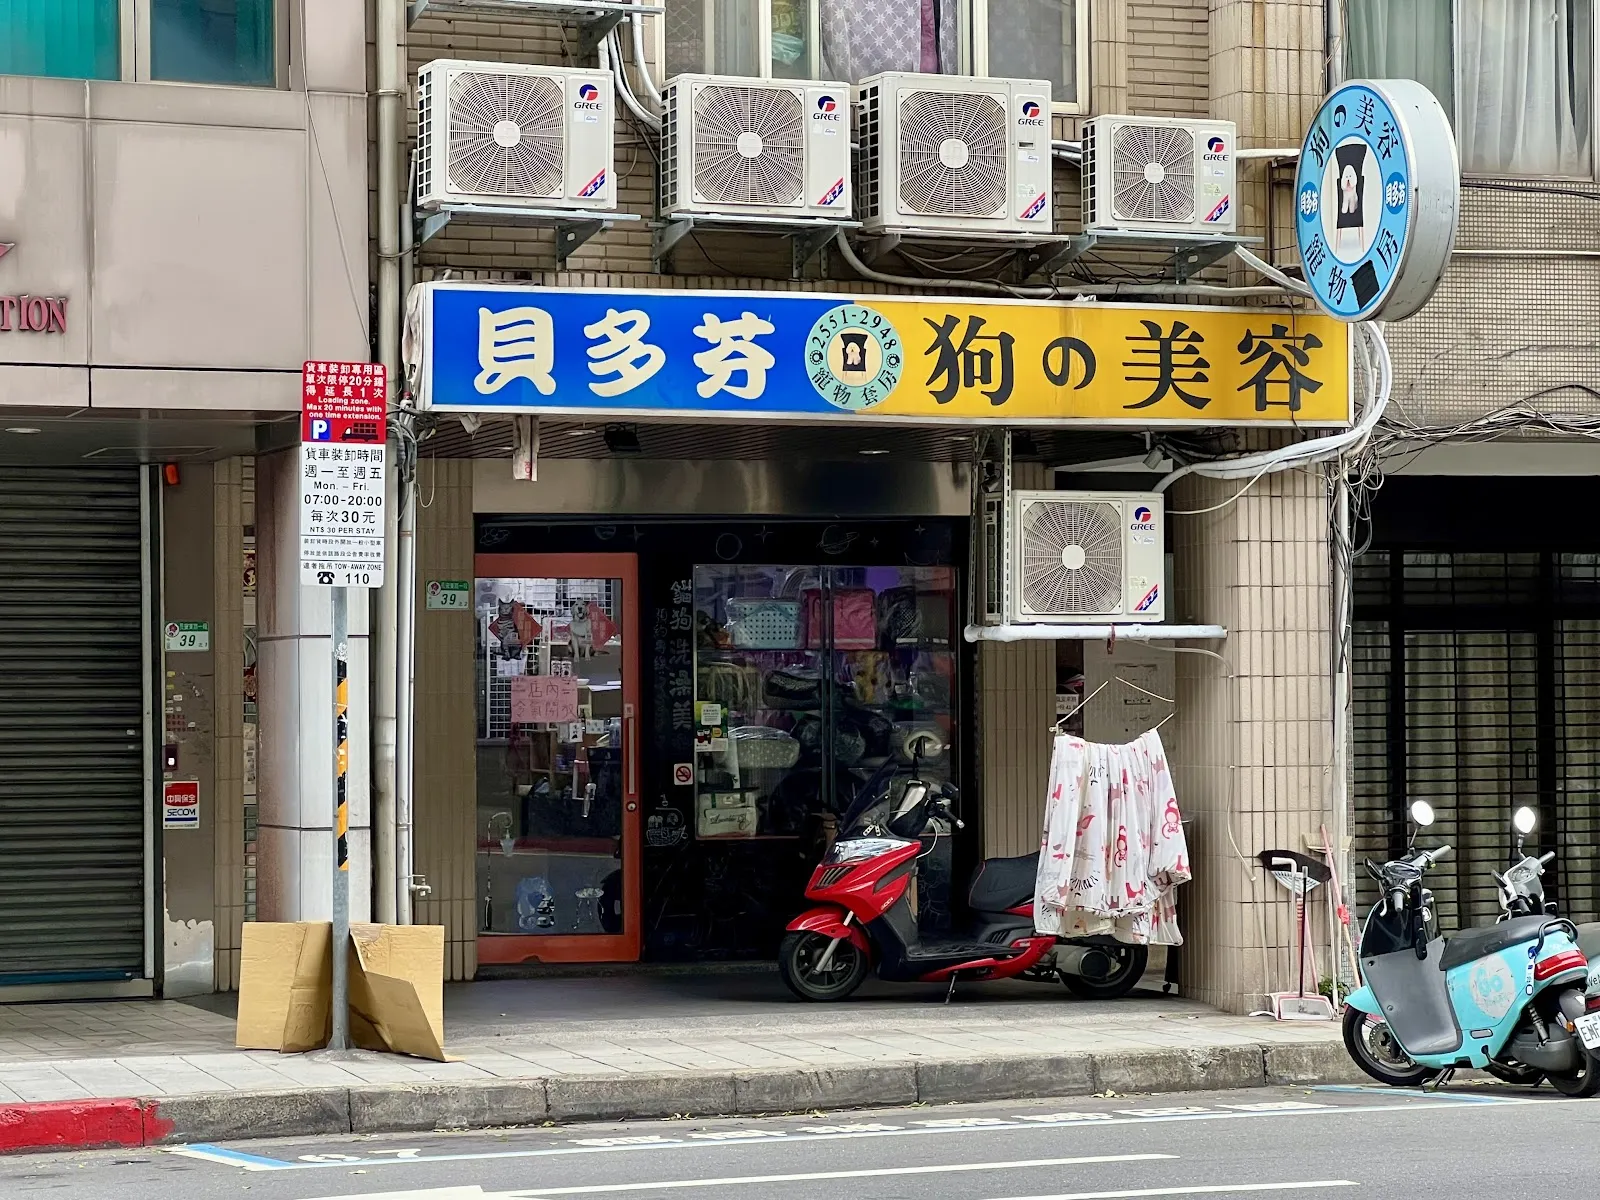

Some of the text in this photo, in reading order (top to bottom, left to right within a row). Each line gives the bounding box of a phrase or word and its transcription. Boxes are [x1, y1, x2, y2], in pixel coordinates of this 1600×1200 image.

[574, 101, 603, 111] GREE
[812, 112, 841, 122] GREE
[1017, 117, 1045, 127] GREE
[1308, 94, 1399, 168] 狗の美容
[1203, 153, 1229, 163] GREE
[811, 308, 897, 351] 2551-2948
[473, 306, 776, 400] 貝多芬
[305, 362, 384, 376] 貨車裝卸專用區
[922, 313, 1324, 412] 狗の美容
[305, 373, 384, 387] 單次限停20分鐘
[811, 367, 897, 406] 寵物套房
[318, 396, 349, 405] Loading
[306, 403, 322, 411] Max
[335, 404, 365, 412] minutes
[343, 412, 381, 420] extension.
[312, 419, 328, 440] P
[305, 447, 383, 463] 貨車裝卸時間
[304, 464, 382, 480] 週一至週五
[313, 481, 339, 490] Mon.
[352, 482, 370, 491] Fri.
[304, 494, 382, 507] 07:00-20:00
[310, 509, 376, 524] 每次30元
[355, 527, 376, 535] STAY
[1130, 523, 1156, 531] GREE
[366, 563, 382, 571] ZONE
[345, 572, 370, 585] 110
[441, 593, 456, 605] 39
[179, 634, 196, 647] 39
[669, 578, 693, 748] 貓狗洗澡美
[166, 794, 196, 804] 中興保全
[166, 808, 196, 817] SECOM
